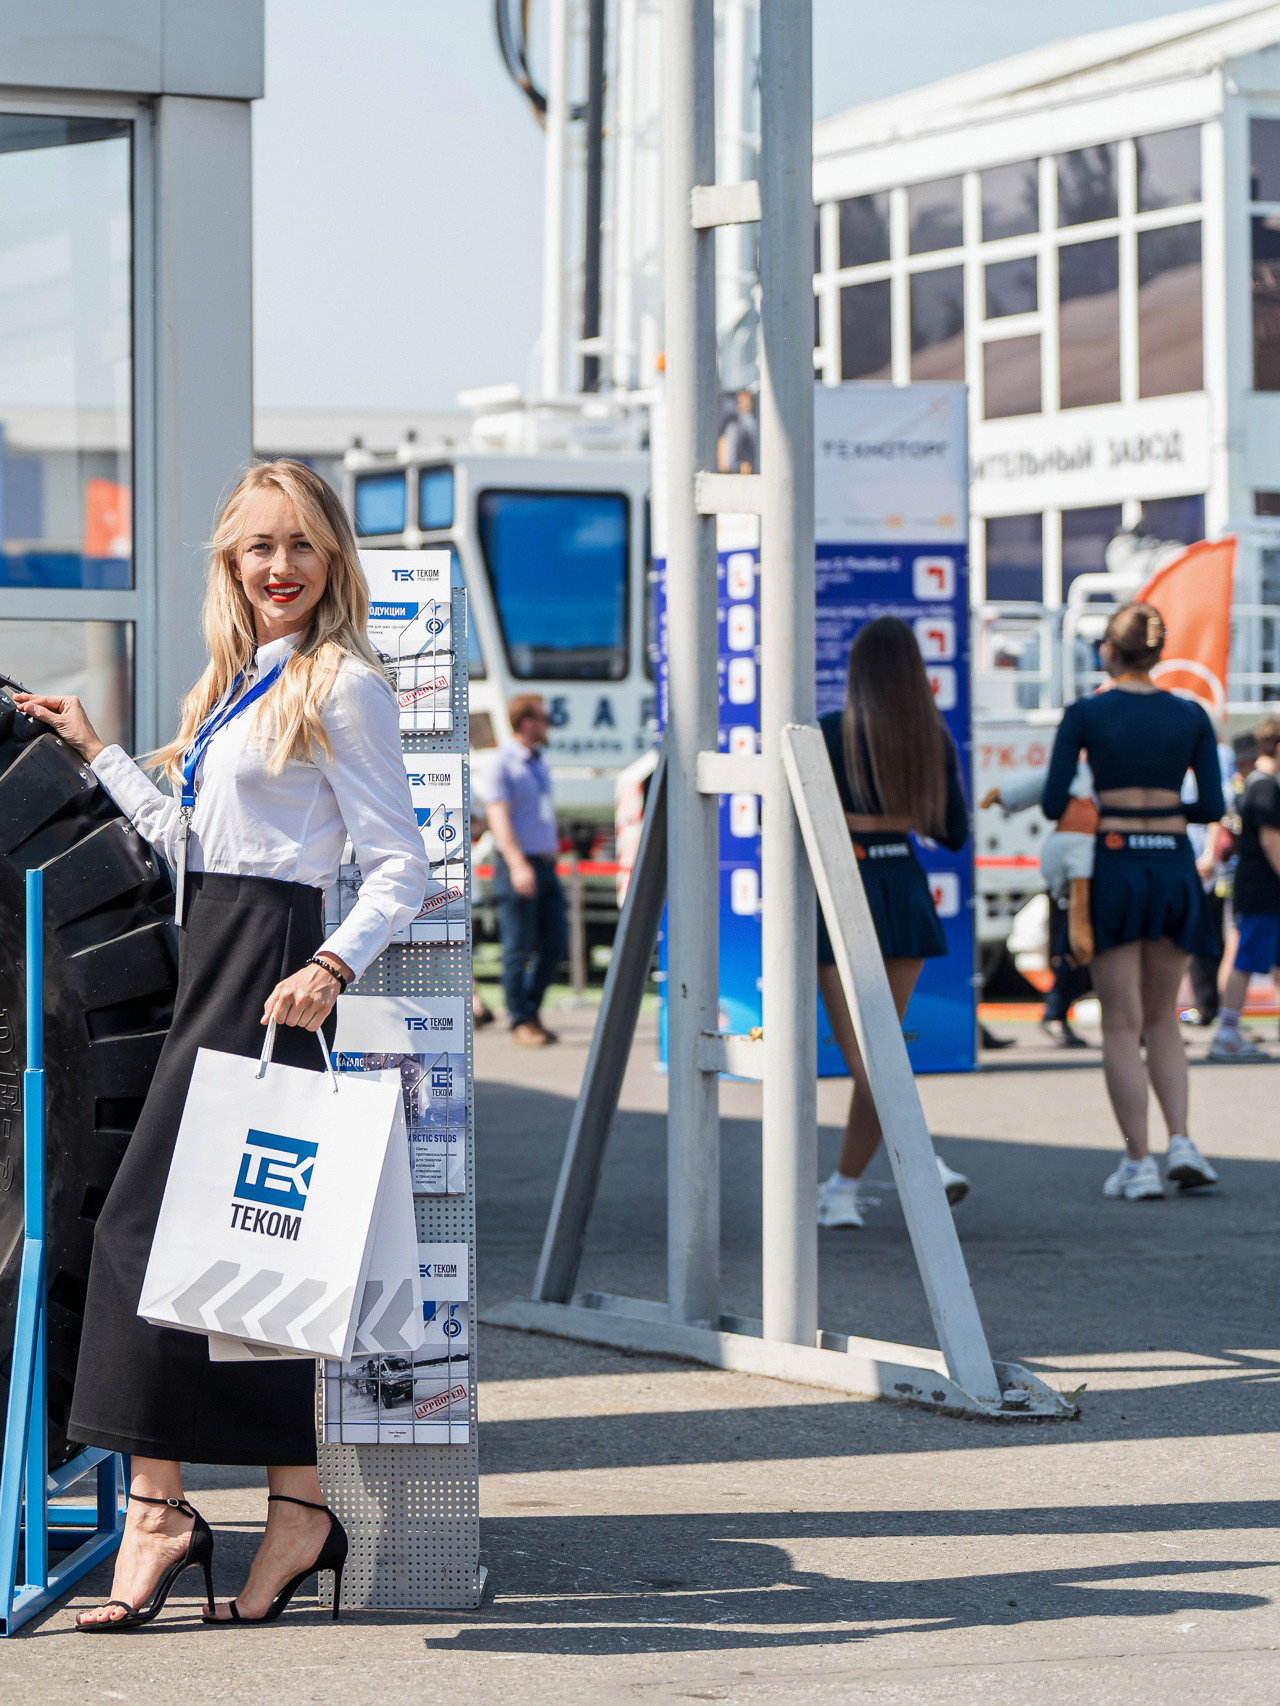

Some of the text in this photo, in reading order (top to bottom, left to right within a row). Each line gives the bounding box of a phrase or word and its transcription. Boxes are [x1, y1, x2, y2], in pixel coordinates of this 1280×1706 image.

[392, 569, 439, 581] ТЕК ТЕКОМ
[369, 606, 406, 617] ОДУКЦИИ
[428, 773, 451, 782] ТЕКОМ
[420, 889, 460, 913] PPROVED
[405, 1017, 453, 1031] ТЕК ТЕКОМ
[434, 1134, 457, 1143] STUDS
[230, 1203, 302, 1241] ТЕКОМ
[419, 1264, 457, 1278] ЕК ТЕКОМ
[417, 1388, 464, 1415] APPROVED
